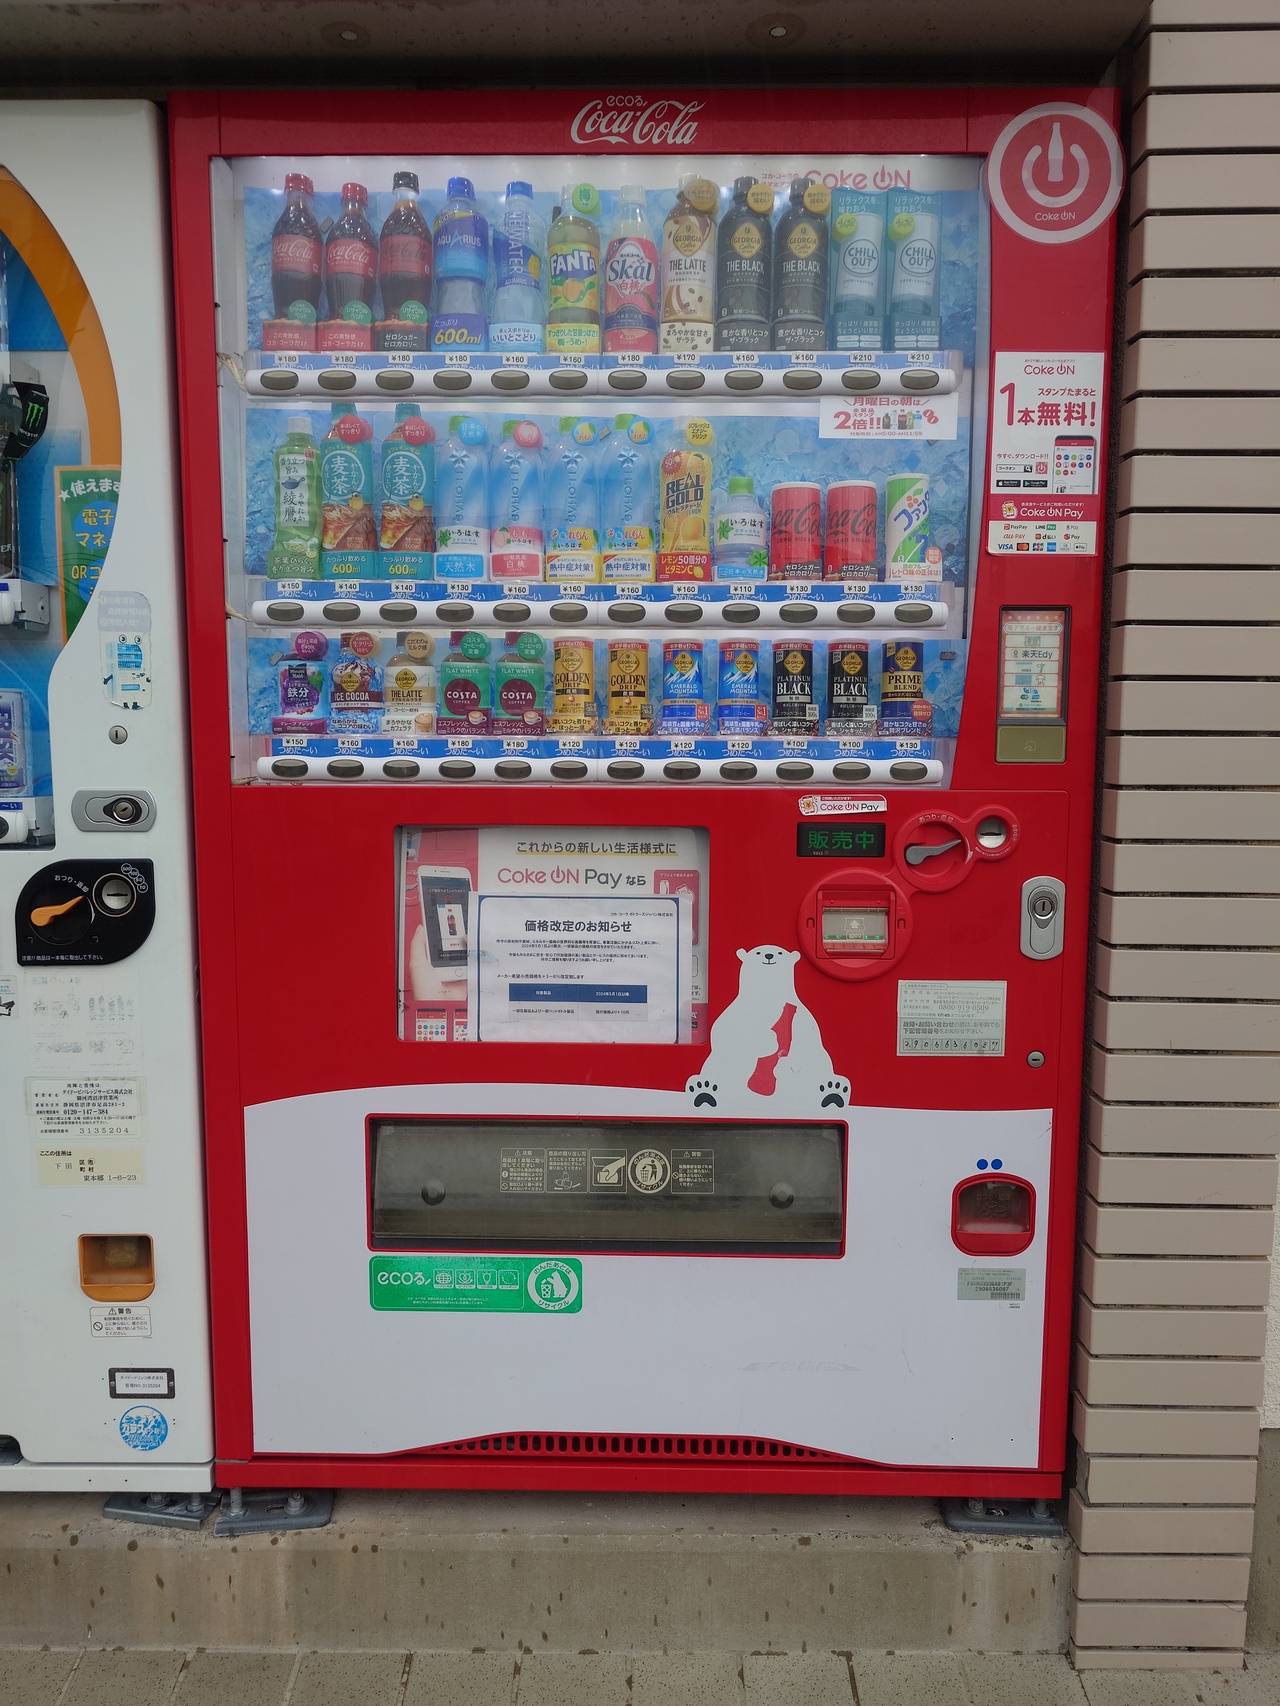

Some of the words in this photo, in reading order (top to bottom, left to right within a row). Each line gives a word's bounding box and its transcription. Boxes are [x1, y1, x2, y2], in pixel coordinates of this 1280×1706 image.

[571, 100, 707, 144] Coca-Cola
[1035, 212, 1059, 221] Coke
[1061, 211, 1075, 219] ON
[438, 230, 481, 248] AQUARIUS
[675, 235, 701, 243] GEORGIA
[734, 236, 760, 244] GEORGIA
[790, 237, 816, 245] GEORGIA
[849, 247, 875, 260] CHILL
[906, 247, 933, 260] CHILL
[551, 250, 597, 275] FANTA
[670, 261, 682, 271] THE
[683, 260, 706, 272] LATTE
[727, 262, 740, 272] THE
[742, 260, 764, 273] BLACK
[783, 262, 796, 272] THE
[797, 261, 820, 274] BLACK
[852, 257, 873, 267] OUT
[909, 257, 930, 267] OUT
[434, 319, 458, 327] たっぷり
[434, 329, 481, 344] 600ml
[492, 334, 536, 342] いいとこどり
[1024, 365, 1054, 375] Coke
[1057, 364, 1075, 375] ON
[1038, 388, 1096, 396] スタンプたまると
[853, 397, 921, 406] 月曜日の朝は
[331, 458, 349, 493] 麦茶
[393, 459, 410, 493] 麦茶
[666, 472, 703, 493] REAL
[666, 488, 703, 509] GOLD
[82, 509, 114, 525] 電子
[1020, 508, 1046, 517] Coke
[1047, 507, 1063, 517] ON
[1064, 508, 1083, 519] Pay
[661, 556, 707, 564] レモン50個分の
[332, 564, 361, 574] 600ml
[389, 565, 418, 575] 600ml
[444, 562, 475, 572] 天然水
[665, 565, 693, 573] ビタミンC
[1021, 650, 1052, 659] 楽天Edy
[555, 673, 589, 683] GOLDEN
[611, 675, 645, 686] GOLDEN
[888, 675, 921, 684] PRIME
[287, 687, 309, 697] 鉄分
[777, 683, 811, 694] BLACK
[834, 683, 867, 696] BLACK
[345, 692, 369, 700] COCOA
[820, 803, 843, 811] Coke
[845, 801, 859, 810] ON
[861, 803, 879, 811] Pay
[808, 831, 874, 849] 販売中
[517, 841, 676, 854] これからの新しい生活様式に
[498, 868, 546, 884] Coke
[551, 866, 579, 884] ON
[585, 869, 622, 888] Pay
[626, 875, 646, 885] なら
[55, 875, 89, 892] おつり・返却
[525, 920, 632, 932] 価格改定のお知らせ
[636, 1179, 663, 1191] リサイクル
[534, 1262, 572, 1275] のんだあとは
[538, 1299, 569, 1309] リサイクル
